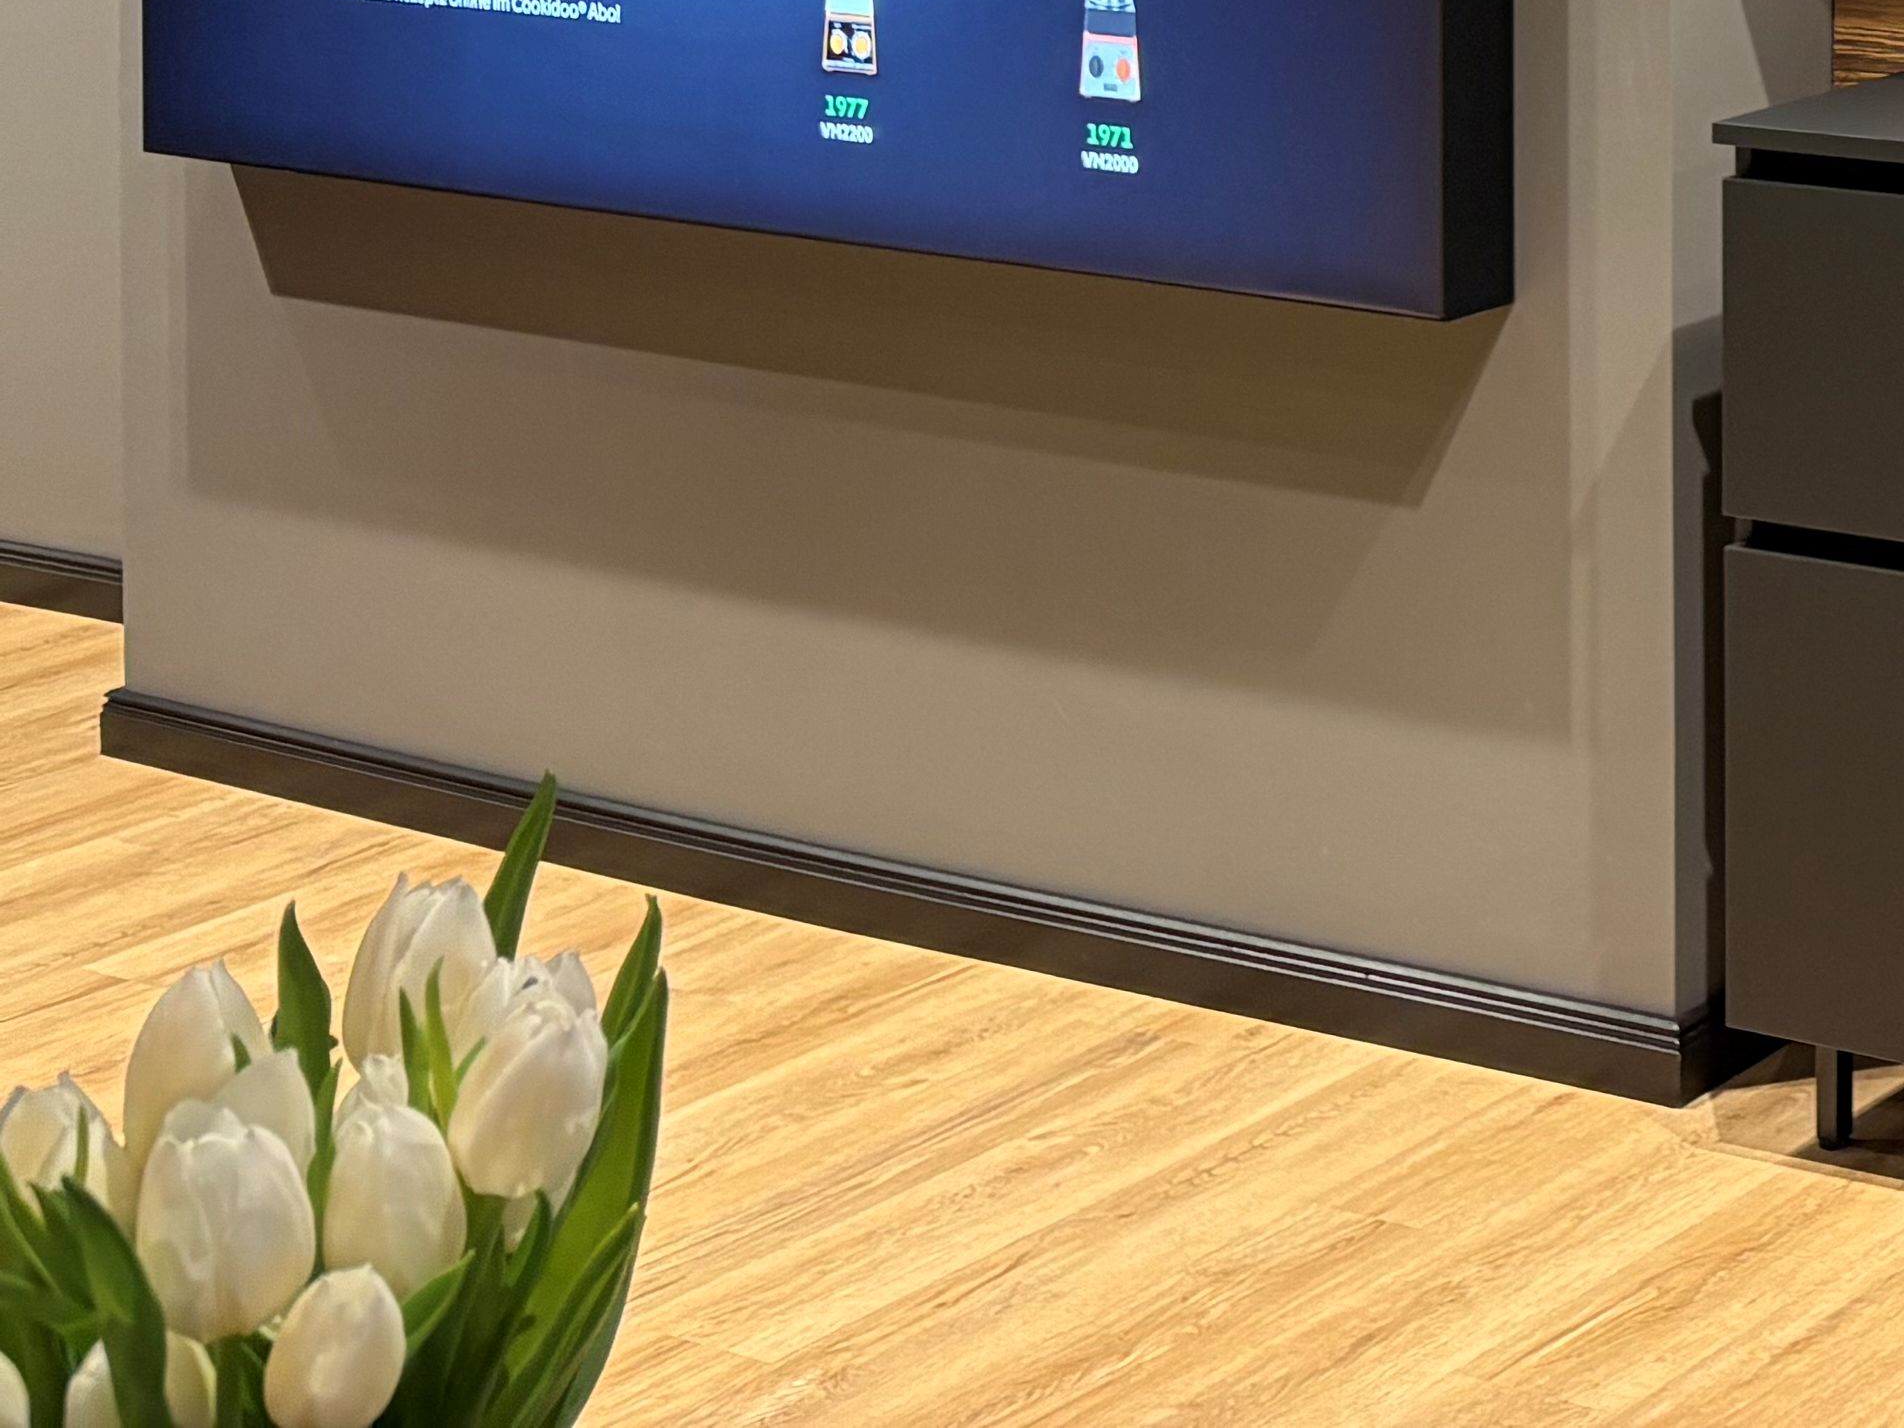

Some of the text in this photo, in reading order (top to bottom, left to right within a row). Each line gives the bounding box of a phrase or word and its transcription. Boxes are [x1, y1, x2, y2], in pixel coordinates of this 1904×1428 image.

[586, 1, 622, 24] Abo!
[824, 94, 870, 120] 1977
[1085, 122, 1135, 150] 1971
